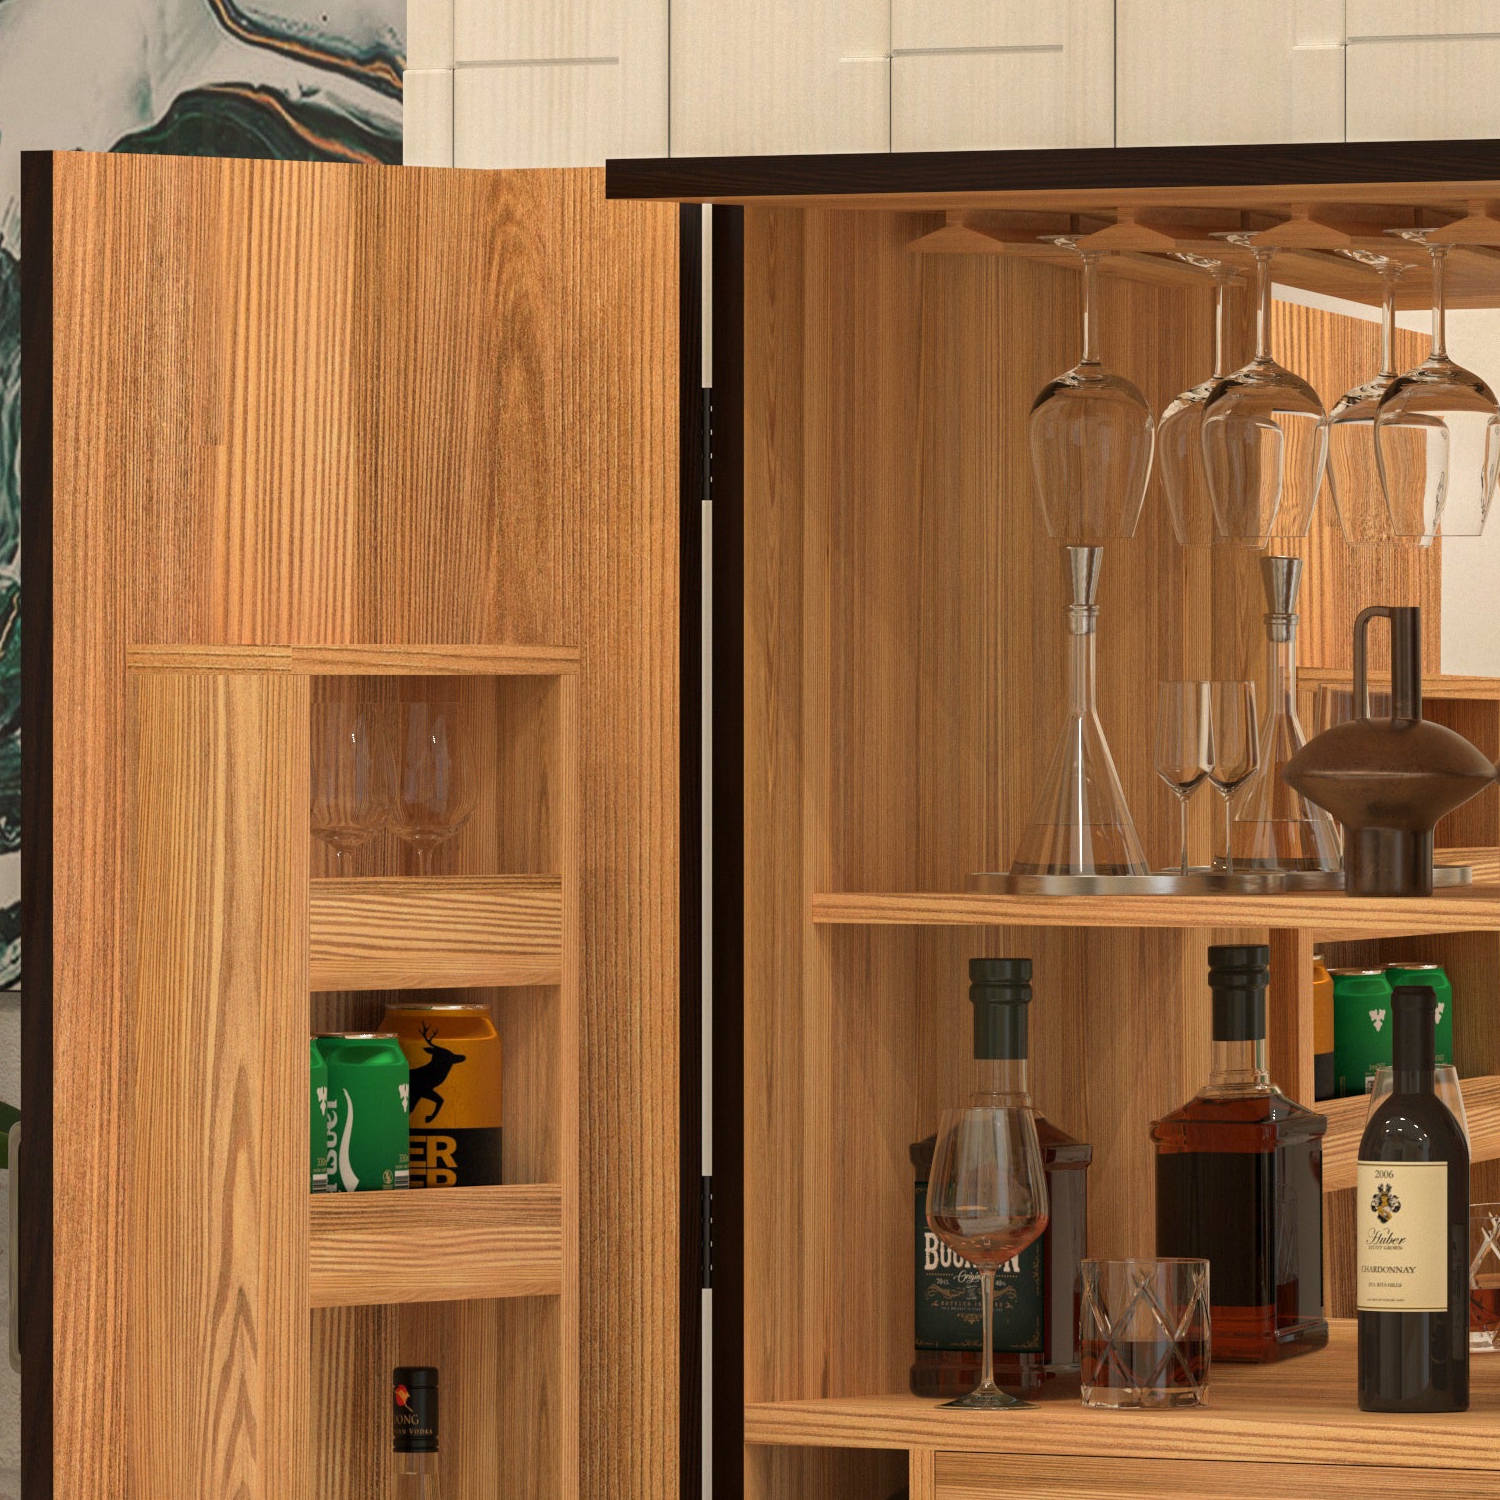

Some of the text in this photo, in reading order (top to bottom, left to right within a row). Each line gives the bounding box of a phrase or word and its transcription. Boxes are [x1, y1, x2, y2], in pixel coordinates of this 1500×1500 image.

[1374, 1169, 1394, 1179] 2006
[1366, 1227, 1406, 1245] Huber
[1361, 1265, 1416, 1274] CHARDONNAY
